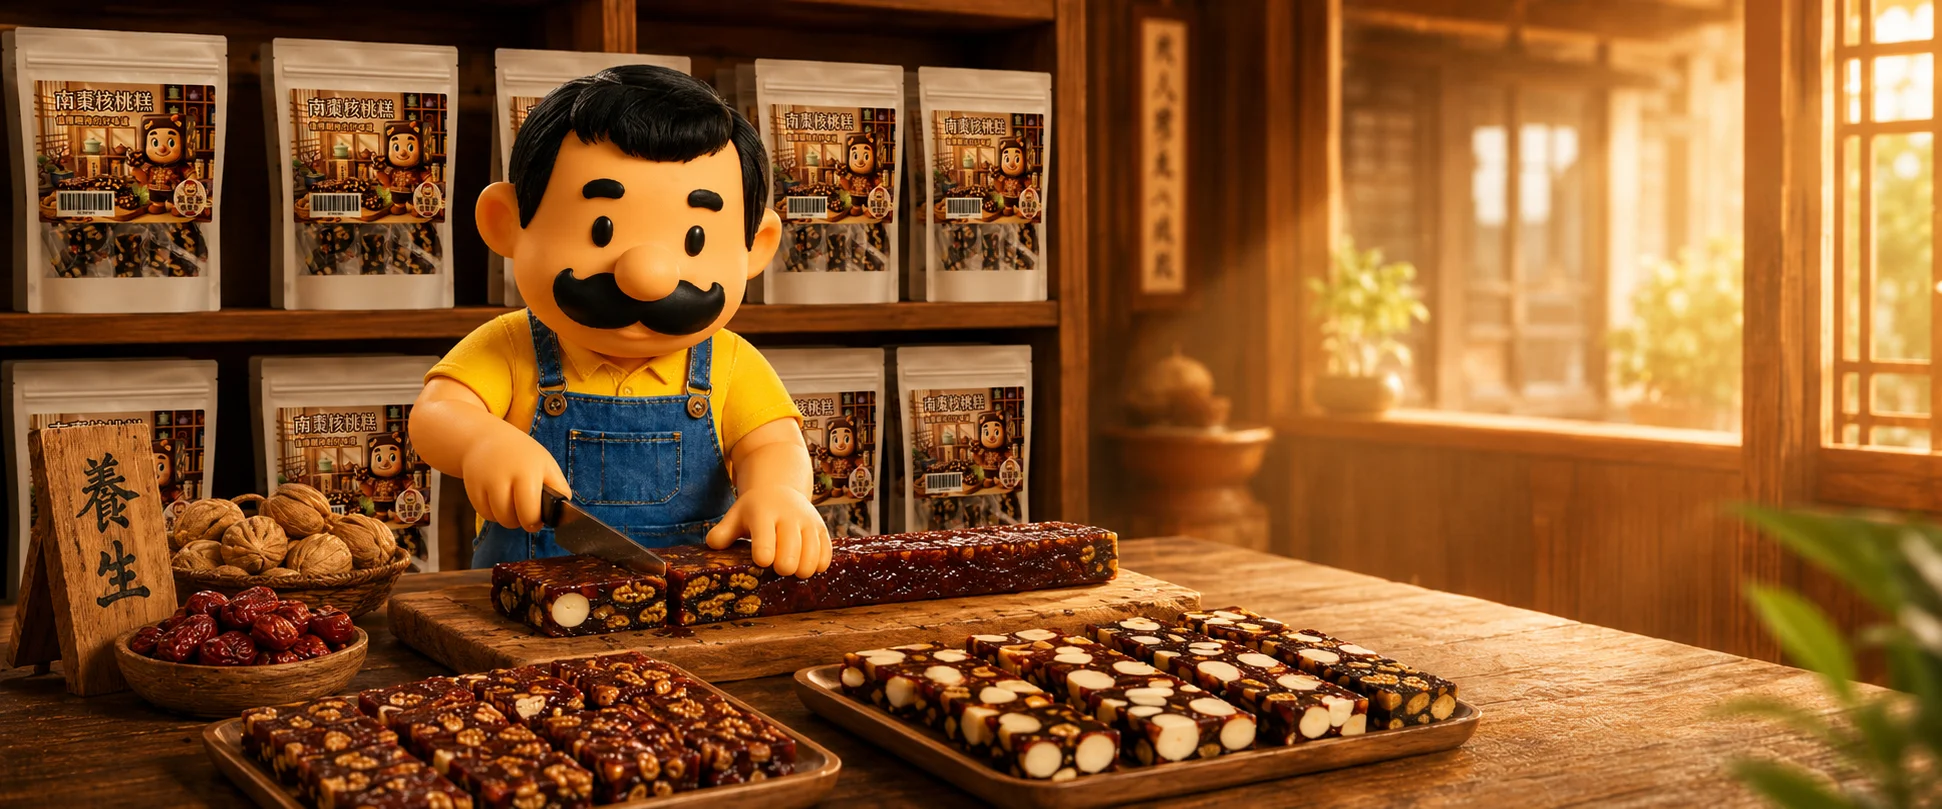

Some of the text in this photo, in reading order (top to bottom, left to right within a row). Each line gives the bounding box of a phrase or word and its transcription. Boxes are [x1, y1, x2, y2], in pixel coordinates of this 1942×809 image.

[54, 89, 154, 112] 南棗核桃糕
[308, 97, 395, 118] 南棗核桃糕
[293, 412, 377, 435] 南棗核桃糕
[76, 452, 150, 608] 養生
